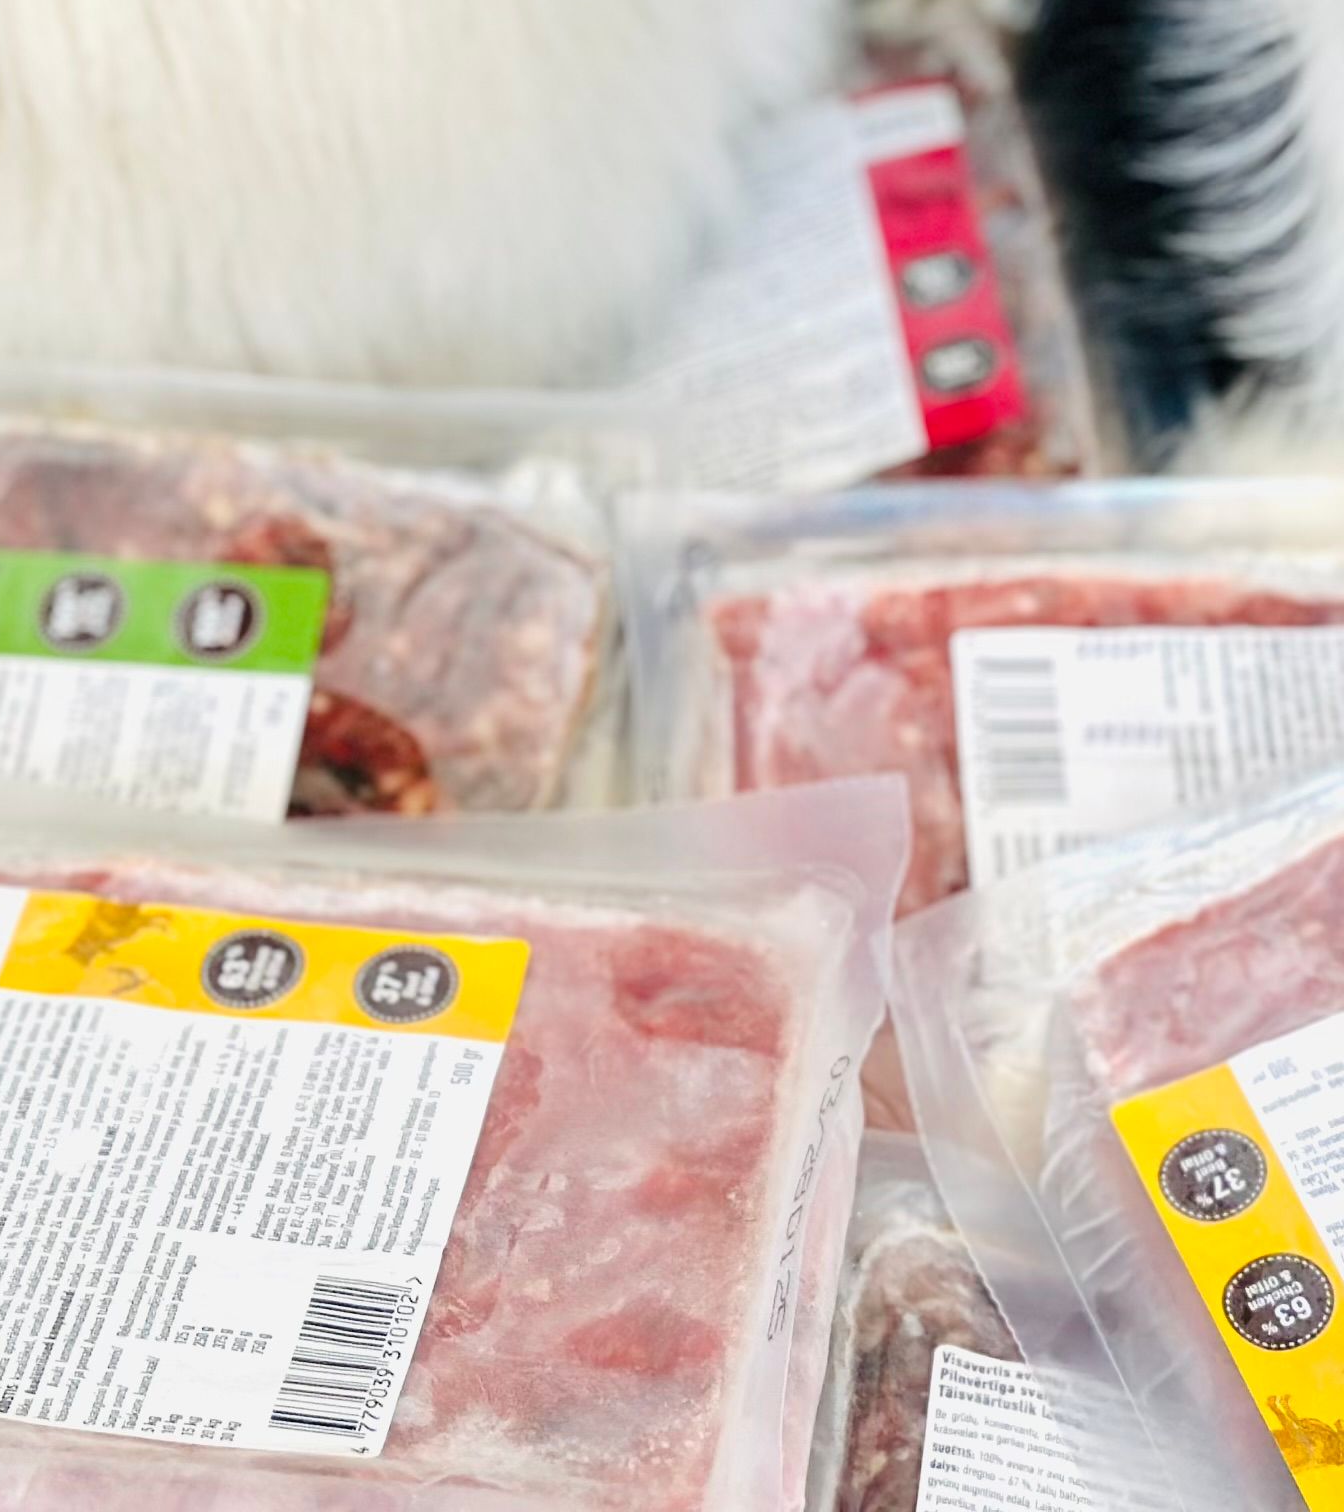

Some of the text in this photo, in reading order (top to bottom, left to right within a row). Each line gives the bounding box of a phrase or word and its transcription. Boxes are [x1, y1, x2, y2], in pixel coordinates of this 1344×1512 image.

[450, 1048, 483, 1084] 500 gr
[1176, 1146, 1217, 1173] Offal
[1188, 1165, 1250, 1209] 37%
[1242, 1267, 1293, 1299] & Offal
[1245, 1278, 1305, 1314] Chicken
[1253, 1292, 1316, 1338] 63%
[351, 1294, 418, 1454] 4 779039 310102
[942, 1351, 1010, 1378] Visavertis
[935, 1408, 947, 1419] Be
[938, 1384, 1037, 1416] Täisväärtuslik
[930, 1458, 959, 1474] dalys:
